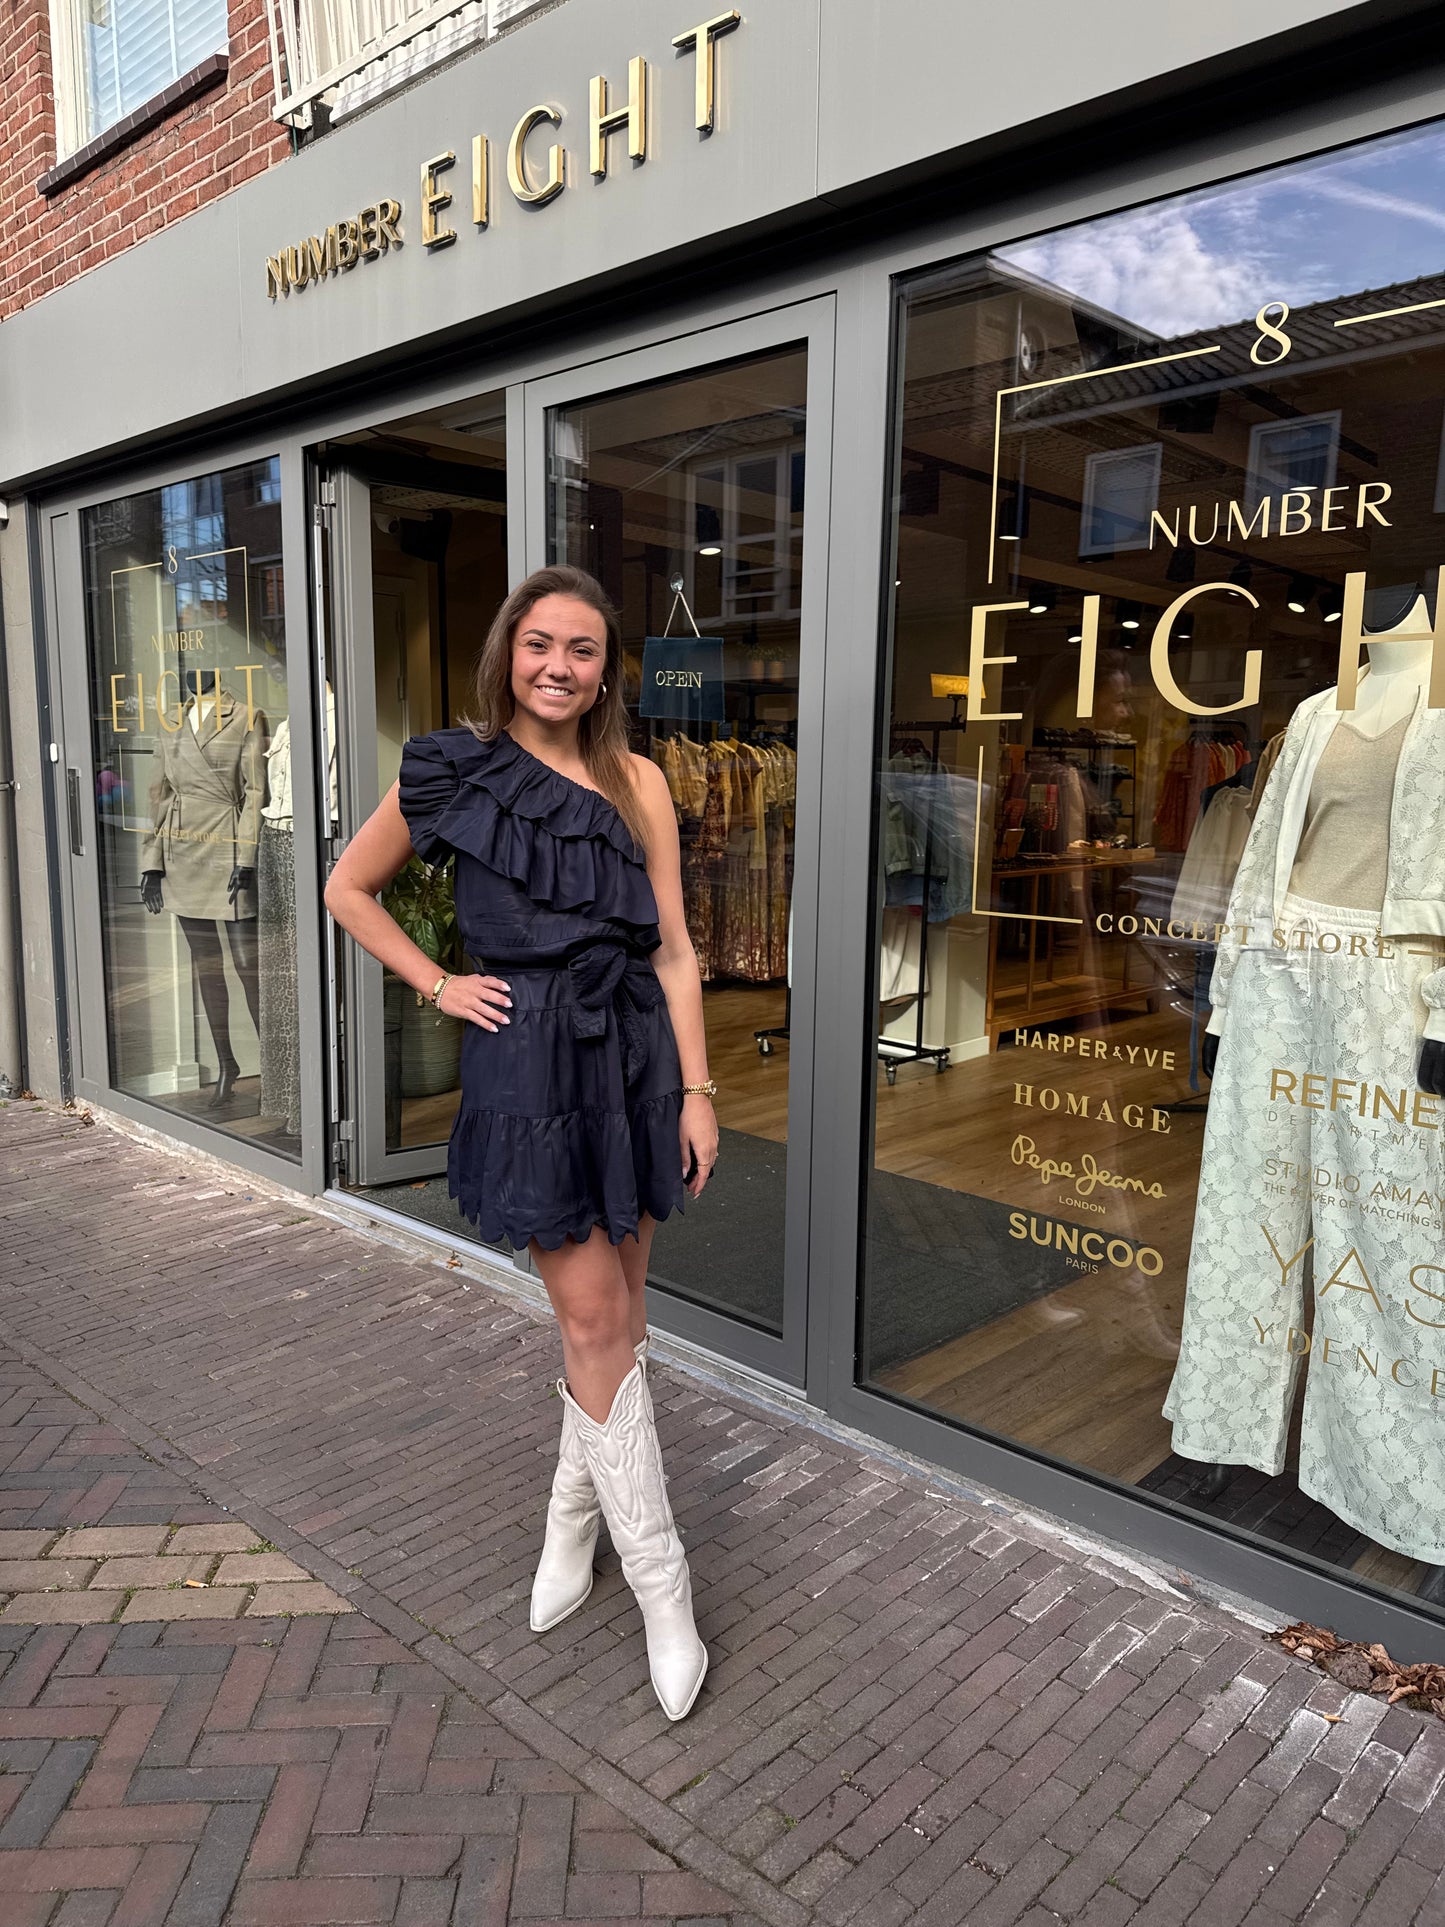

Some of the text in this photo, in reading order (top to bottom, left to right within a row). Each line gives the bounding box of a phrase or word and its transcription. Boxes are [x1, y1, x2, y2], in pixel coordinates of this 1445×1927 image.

[266, 9, 741, 299] NUMBER EIGHT
[1249, 301, 1292, 366] 8
[1149, 482, 1393, 551] NUMBER
[168, 545, 178, 574] 8
[151, 629, 205, 653] NUMBER
[110, 664, 264, 733] EIGHT
[655, 670, 703, 689] OPEN
[1096, 913, 1396, 961] CONCEPT STORE
[1013, 1082, 1172, 1134] HOMAGE
[1270, 1068, 1439, 1130] REFINE
[1011, 1134, 1168, 1199] Pepe Jeans
[1264, 1158, 1361, 1194] STUDIO
[1058, 1195, 1106, 1215] LONDON
[1263, 1181, 1287, 1196] THE
[1339, 1198, 1356, 1210] OF
[1359, 1203, 1431, 1228] MATCHING
[1008, 1212, 1164, 1277] SUNCOO
[1065, 1256, 1099, 1275] PARIS
